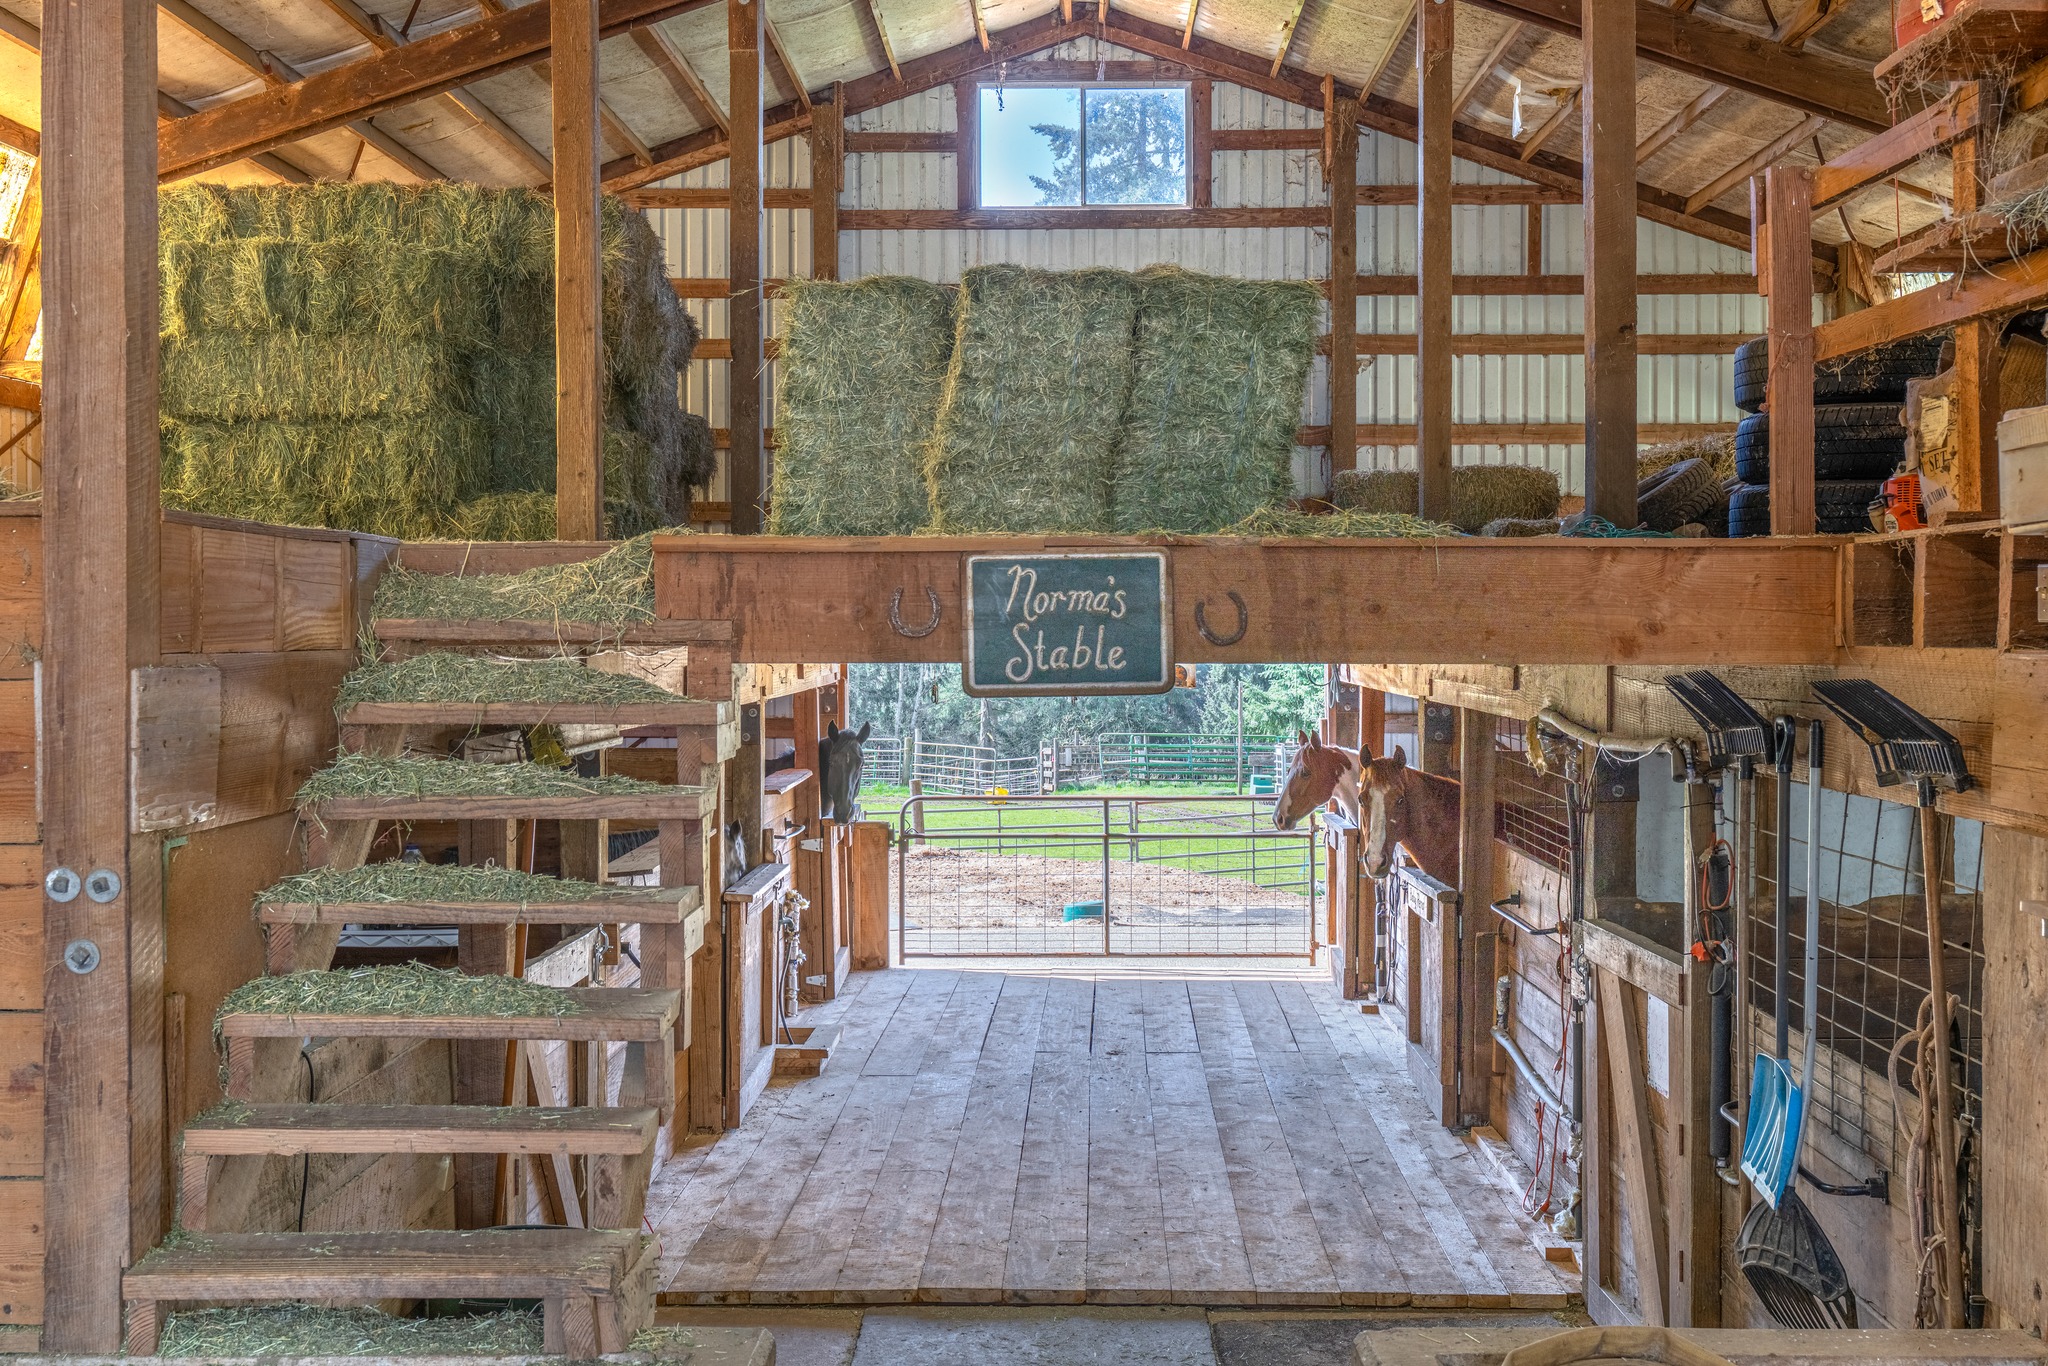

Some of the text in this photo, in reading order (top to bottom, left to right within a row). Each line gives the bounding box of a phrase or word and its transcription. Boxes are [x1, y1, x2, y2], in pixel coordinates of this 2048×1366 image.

[1927, 449, 1948, 473] SET
[1006, 564, 1127, 621] Norma's
[1005, 622, 1127, 682] Stable
